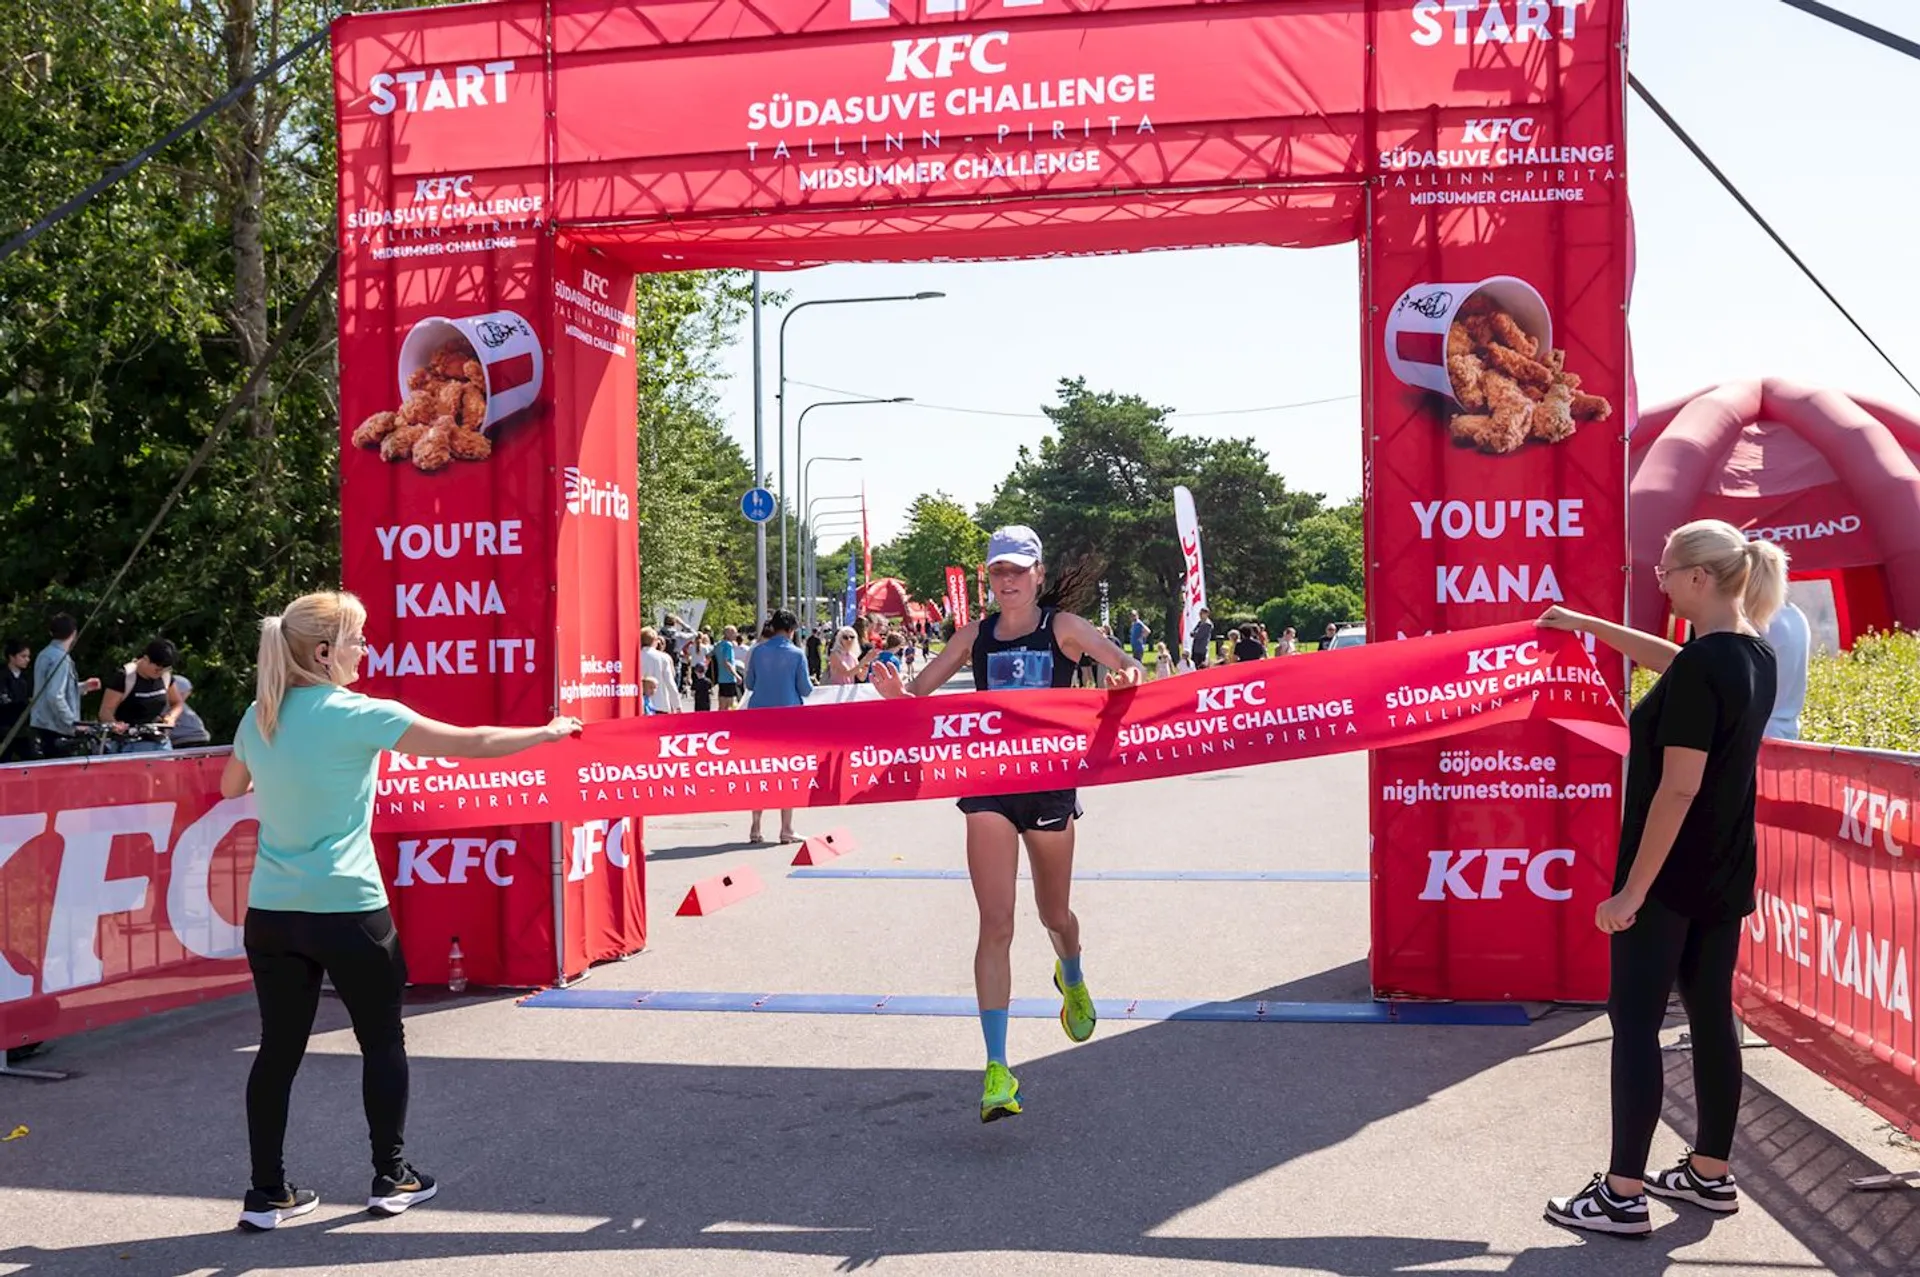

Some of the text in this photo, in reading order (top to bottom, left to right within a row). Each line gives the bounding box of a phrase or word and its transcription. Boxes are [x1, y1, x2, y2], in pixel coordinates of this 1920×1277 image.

[1410, 0, 1586, 46] START
[887, 31, 1009, 83] KFC
[368, 61, 515, 116] START
[748, 73, 1155, 130] SÜDASUVE CHALLENGE
[748, 130, 941, 161] TALLINN
[998, 115, 1155, 144] PIRITA
[1461, 117, 1534, 143] KFC
[800, 150, 1100, 190] MIDSUMMER CHALLENGE
[1380, 145, 1614, 169] SÜDASUVE CHALLENGE
[414, 175, 474, 202] KFC
[1380, 171, 1494, 187] TALLINN
[1526, 168, 1615, 183] PIRITA
[347, 196, 542, 228] SÜDASUVE CHALLENGE
[1410, 188, 1584, 205] MIDSUMMER CHALLENGE
[348, 227, 441, 245] TALLINN
[466, 218, 542, 234] PIRITA
[372, 237, 517, 260] MIDSUMMER CHALLENGE
[582, 269, 609, 299] KFC
[579, 476, 629, 521] Pirita
[1410, 499, 1584, 540] YOU'RE
[375, 520, 522, 561] YOU'RE
[395, 579, 506, 618] KANA
[1436, 564, 1564, 604] KANA
[366, 638, 536, 679] MAKE IT!
[1012, 658, 1025, 679] 3
[1465, 641, 1539, 675] KFC
[1196, 680, 1266, 713] KFC
[1385, 677, 1499, 709] SÜDASUVE
[1388, 698, 1502, 727] TALLINN
[1532, 689, 1616, 708] PIRITA
[931, 711, 1002, 739] KFC
[1118, 699, 1354, 747] SÜDASUVE CHALLENGE
[658, 731, 730, 759] KFC
[850, 735, 1087, 768] SÜDASUVE CHALLENGE
[1120, 738, 1236, 765] TALLINN
[1266, 721, 1357, 745] PIRITA
[578, 754, 818, 783] SÜDASUVE CHALLENGE
[851, 767, 967, 786] TALLINN
[999, 757, 1089, 775] PIRITA
[1438, 750, 1556, 776] ööjooks.ee
[425, 770, 546, 792] CHALLENGE
[580, 784, 697, 801] TALLINN
[728, 776, 820, 793] PIRITA
[1383, 777, 1612, 805] nightrunestonia.com
[458, 793, 549, 809] PIRITA
[1838, 786, 1908, 857] KFC
[393, 838, 517, 886] KFC
[1418, 848, 1575, 901] KFC
[1819, 915, 1912, 1022] KANA
